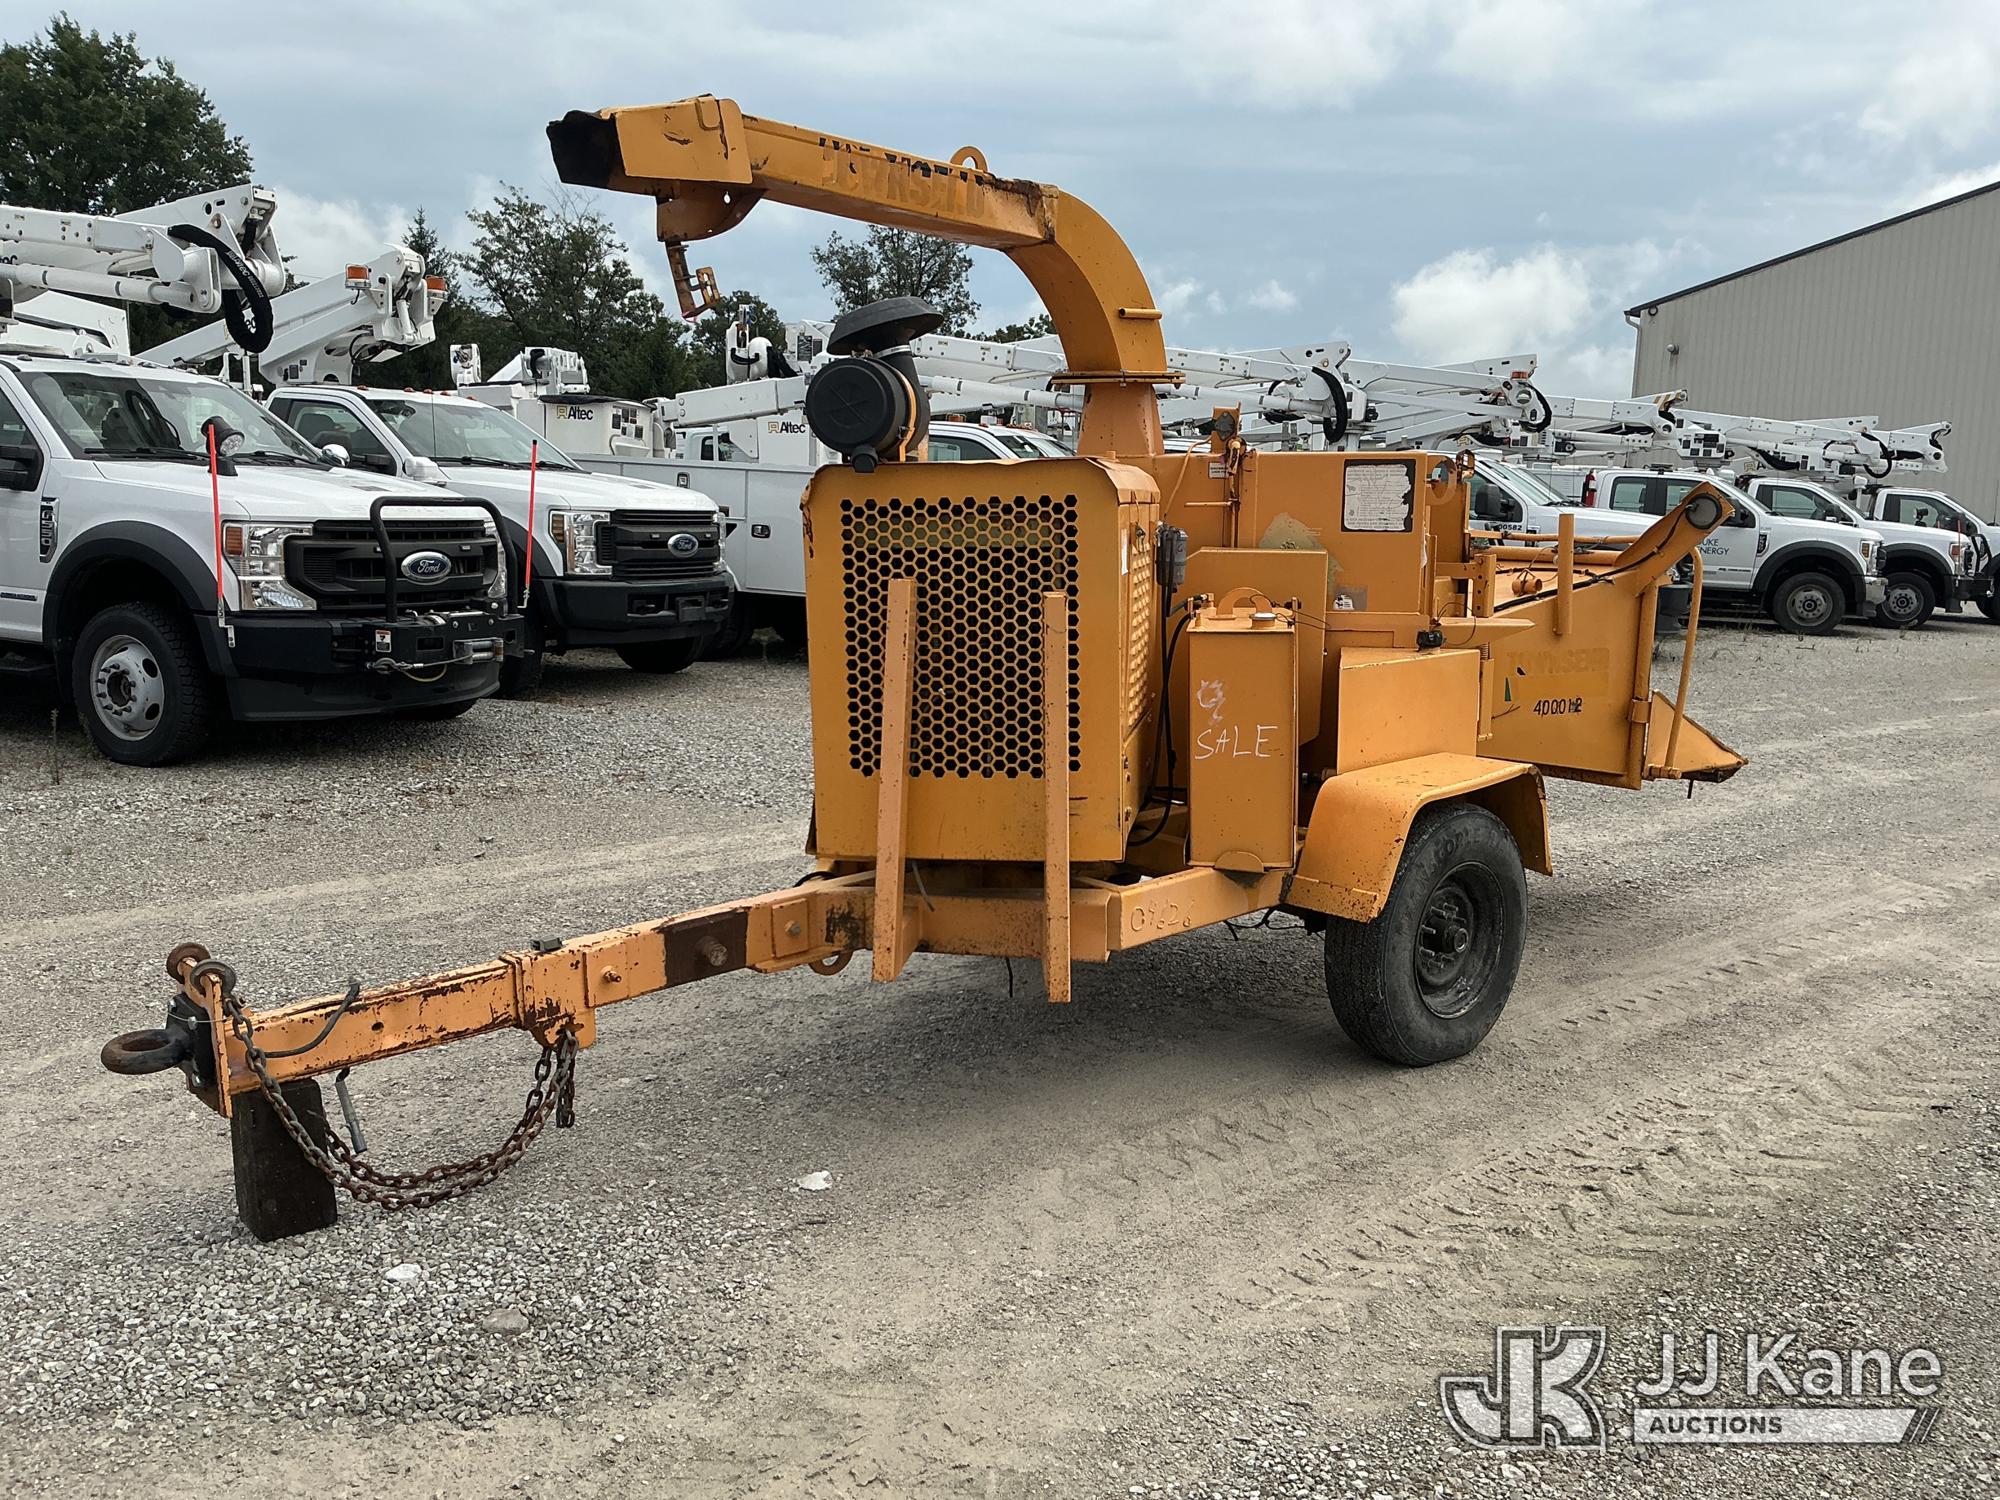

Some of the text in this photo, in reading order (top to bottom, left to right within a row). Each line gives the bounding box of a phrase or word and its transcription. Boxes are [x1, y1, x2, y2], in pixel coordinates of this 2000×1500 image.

[568, 405, 594, 420] Altec
[780, 421, 806, 433] Altec
[1702, 538, 1719, 547] UKE
[1699, 546, 1730, 556] NERGY
[417, 559, 442, 574] Ford
[1194, 724, 1279, 760] SALE
